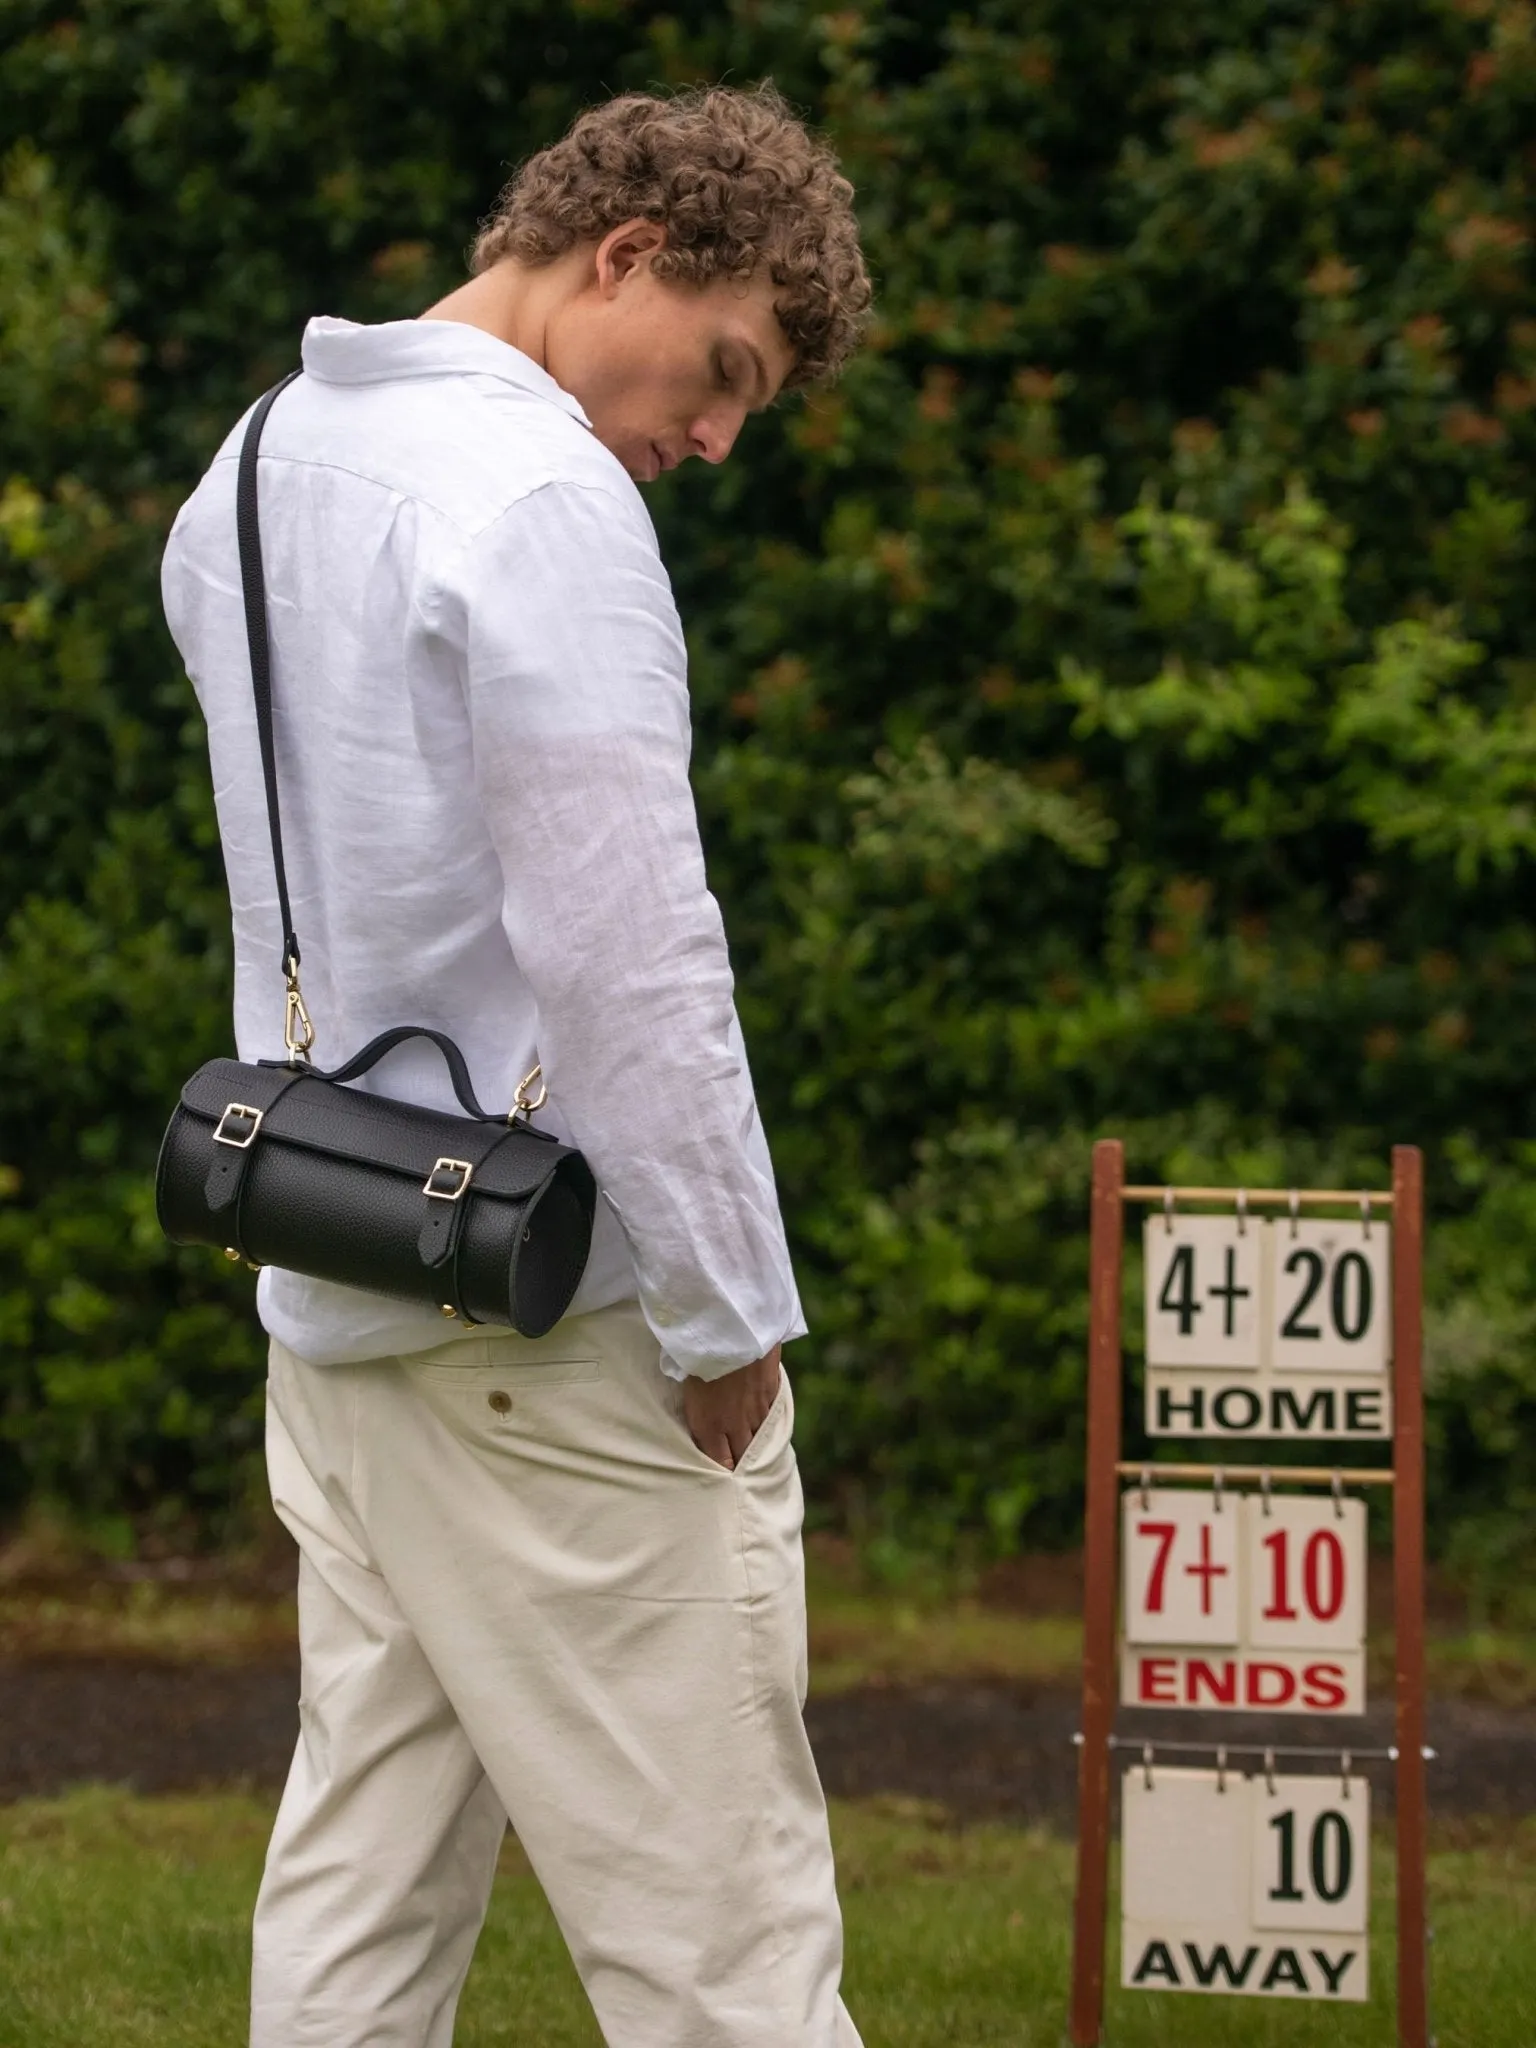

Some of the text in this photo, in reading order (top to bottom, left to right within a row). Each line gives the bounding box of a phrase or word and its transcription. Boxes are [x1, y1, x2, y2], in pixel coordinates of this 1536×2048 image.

[1279, 1247, 1374, 1343] 20
[1156, 1386, 1383, 1432] HOME
[1262, 1527, 1346, 1621] 10
[1138, 1658, 1347, 1710] ENDS
[1268, 1808, 1352, 1904] 10
[1131, 1940, 1357, 1994] AWAY
